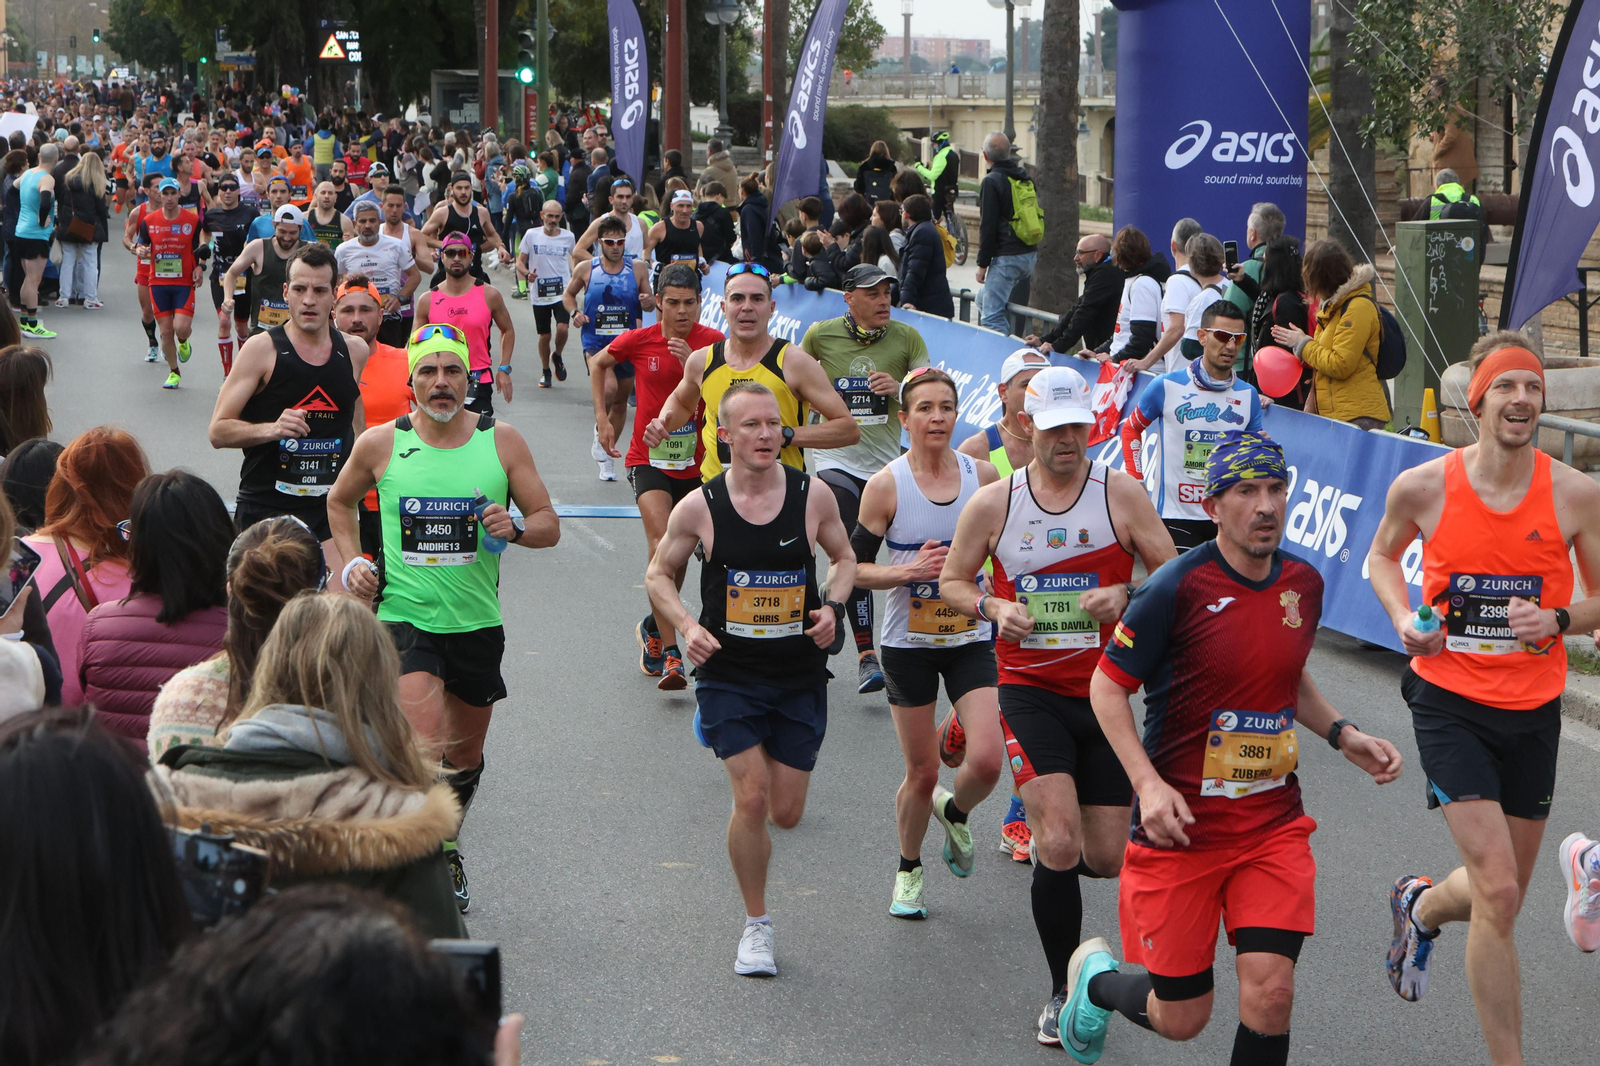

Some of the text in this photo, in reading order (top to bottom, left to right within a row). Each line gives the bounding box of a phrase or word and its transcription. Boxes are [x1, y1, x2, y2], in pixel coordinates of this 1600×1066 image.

[797, 37, 820, 112] asics
[813, 96, 821, 121] sound
[821, 49, 829, 74] sound
[827, 28, 835, 49] body
[1212, 131, 1295, 163] asics
[1204, 174, 1303, 187] sound mind, sound body
[1175, 402, 1220, 424] Family
[302, 442, 335, 450] ZURICH
[300, 461, 320, 470] 3141
[426, 502, 469, 510] ZURICH
[425, 524, 452, 535] 3450
[417, 542, 460, 551] ANDIHE13
[755, 575, 798, 584] ZURICH
[1043, 577, 1089, 588] ZURICH
[1482, 580, 1532, 590] ZURICH
[753, 597, 780, 607] 3718
[1044, 602, 1070, 613] 1781
[856, 597, 868, 626] SURAL
[1480, 605, 1509, 618] 2398
[753, 614, 780, 623] CHRIS
[1033, 621, 1093, 631] ATIAS DAVILA
[1239, 744, 1271, 759] 3881
[1232, 768, 1272, 779] ZUBERO
